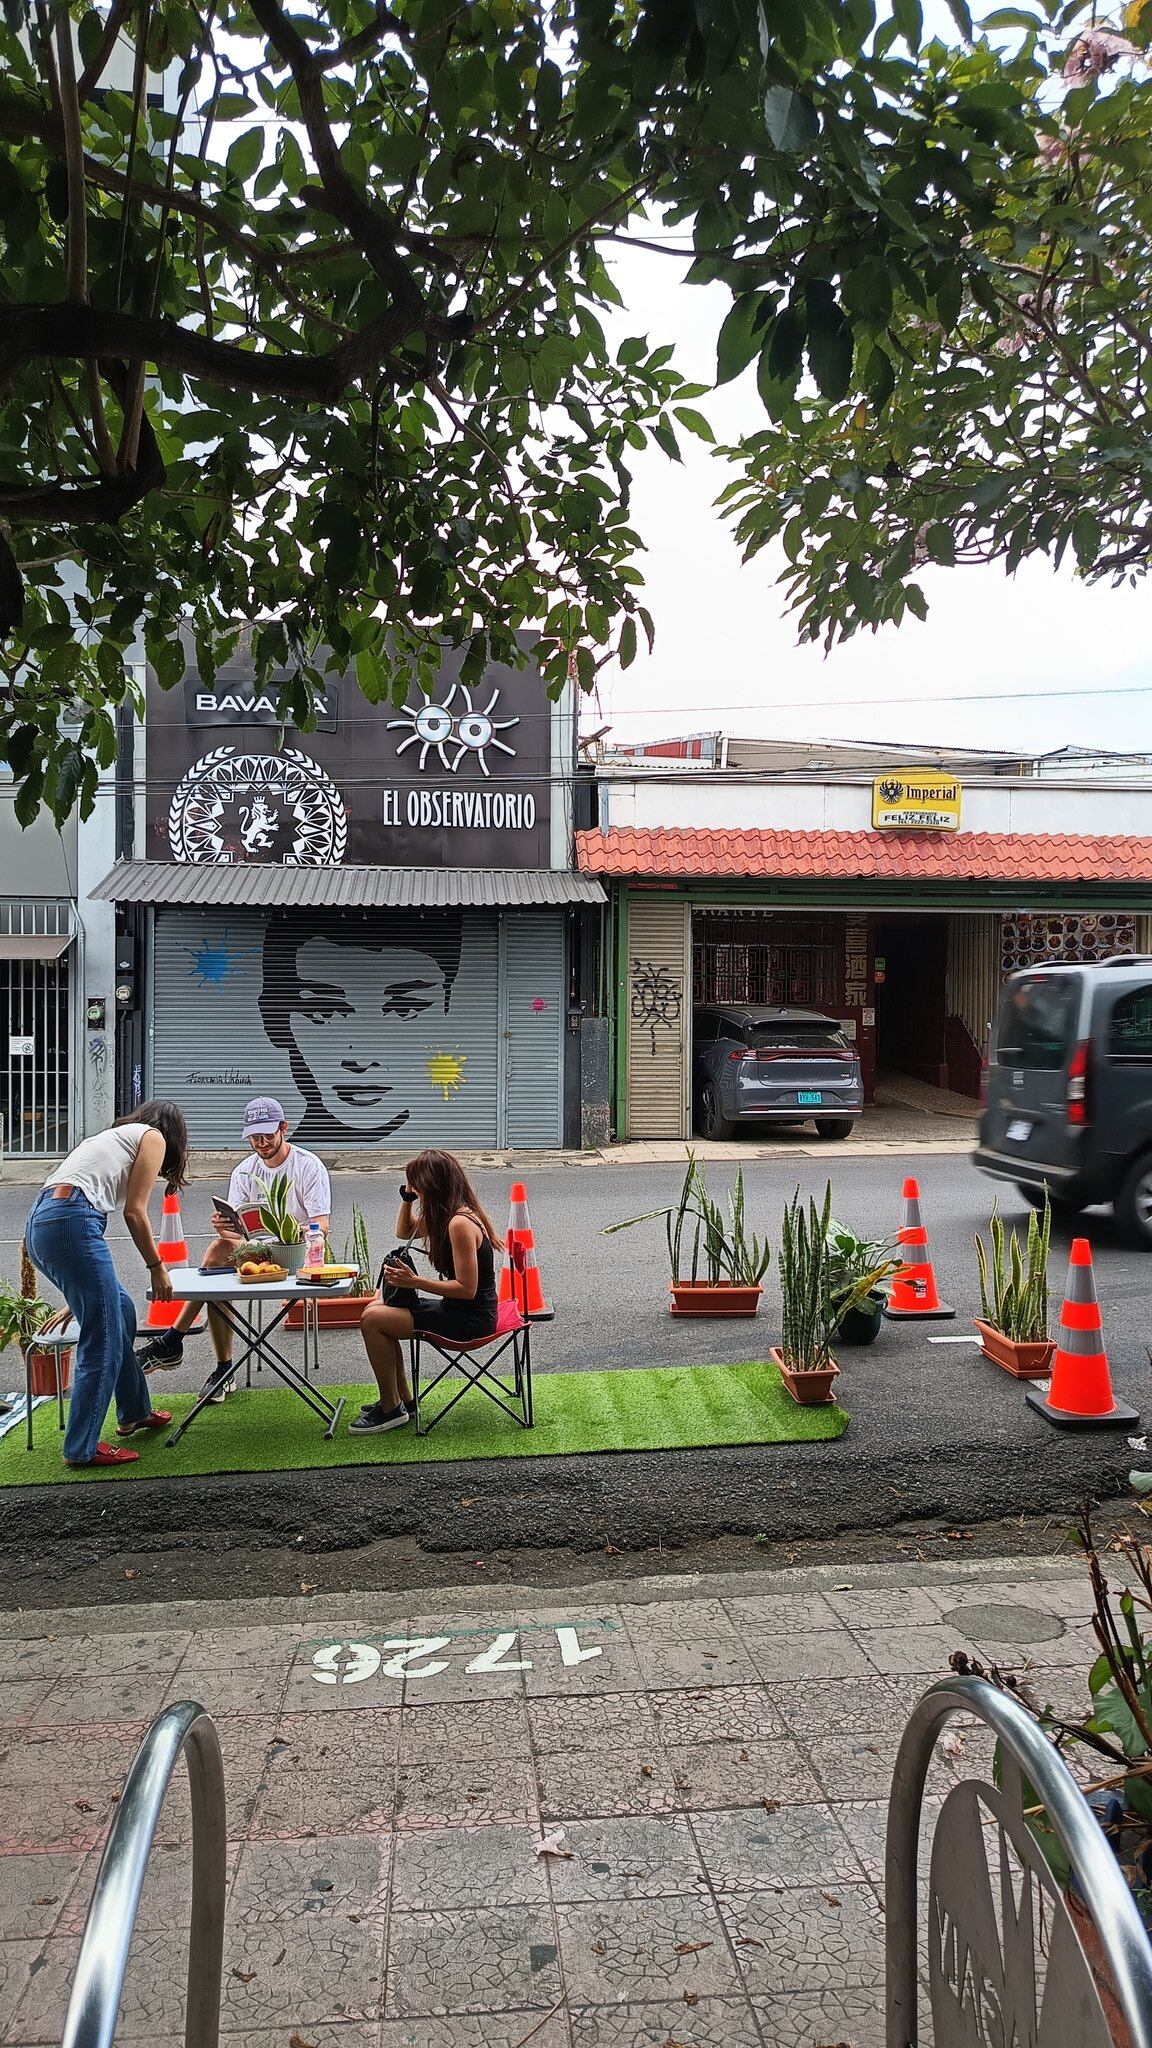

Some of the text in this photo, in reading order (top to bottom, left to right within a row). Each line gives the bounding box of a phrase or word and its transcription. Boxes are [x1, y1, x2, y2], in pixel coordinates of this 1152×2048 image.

[196, 694, 328, 714] BAVAA
[905, 784, 956, 803] Imperial
[383, 790, 536, 829] EL OBSERVATORIO
[919, 814, 950, 823] FELIZ
[310, 1627, 603, 1684] 1726
